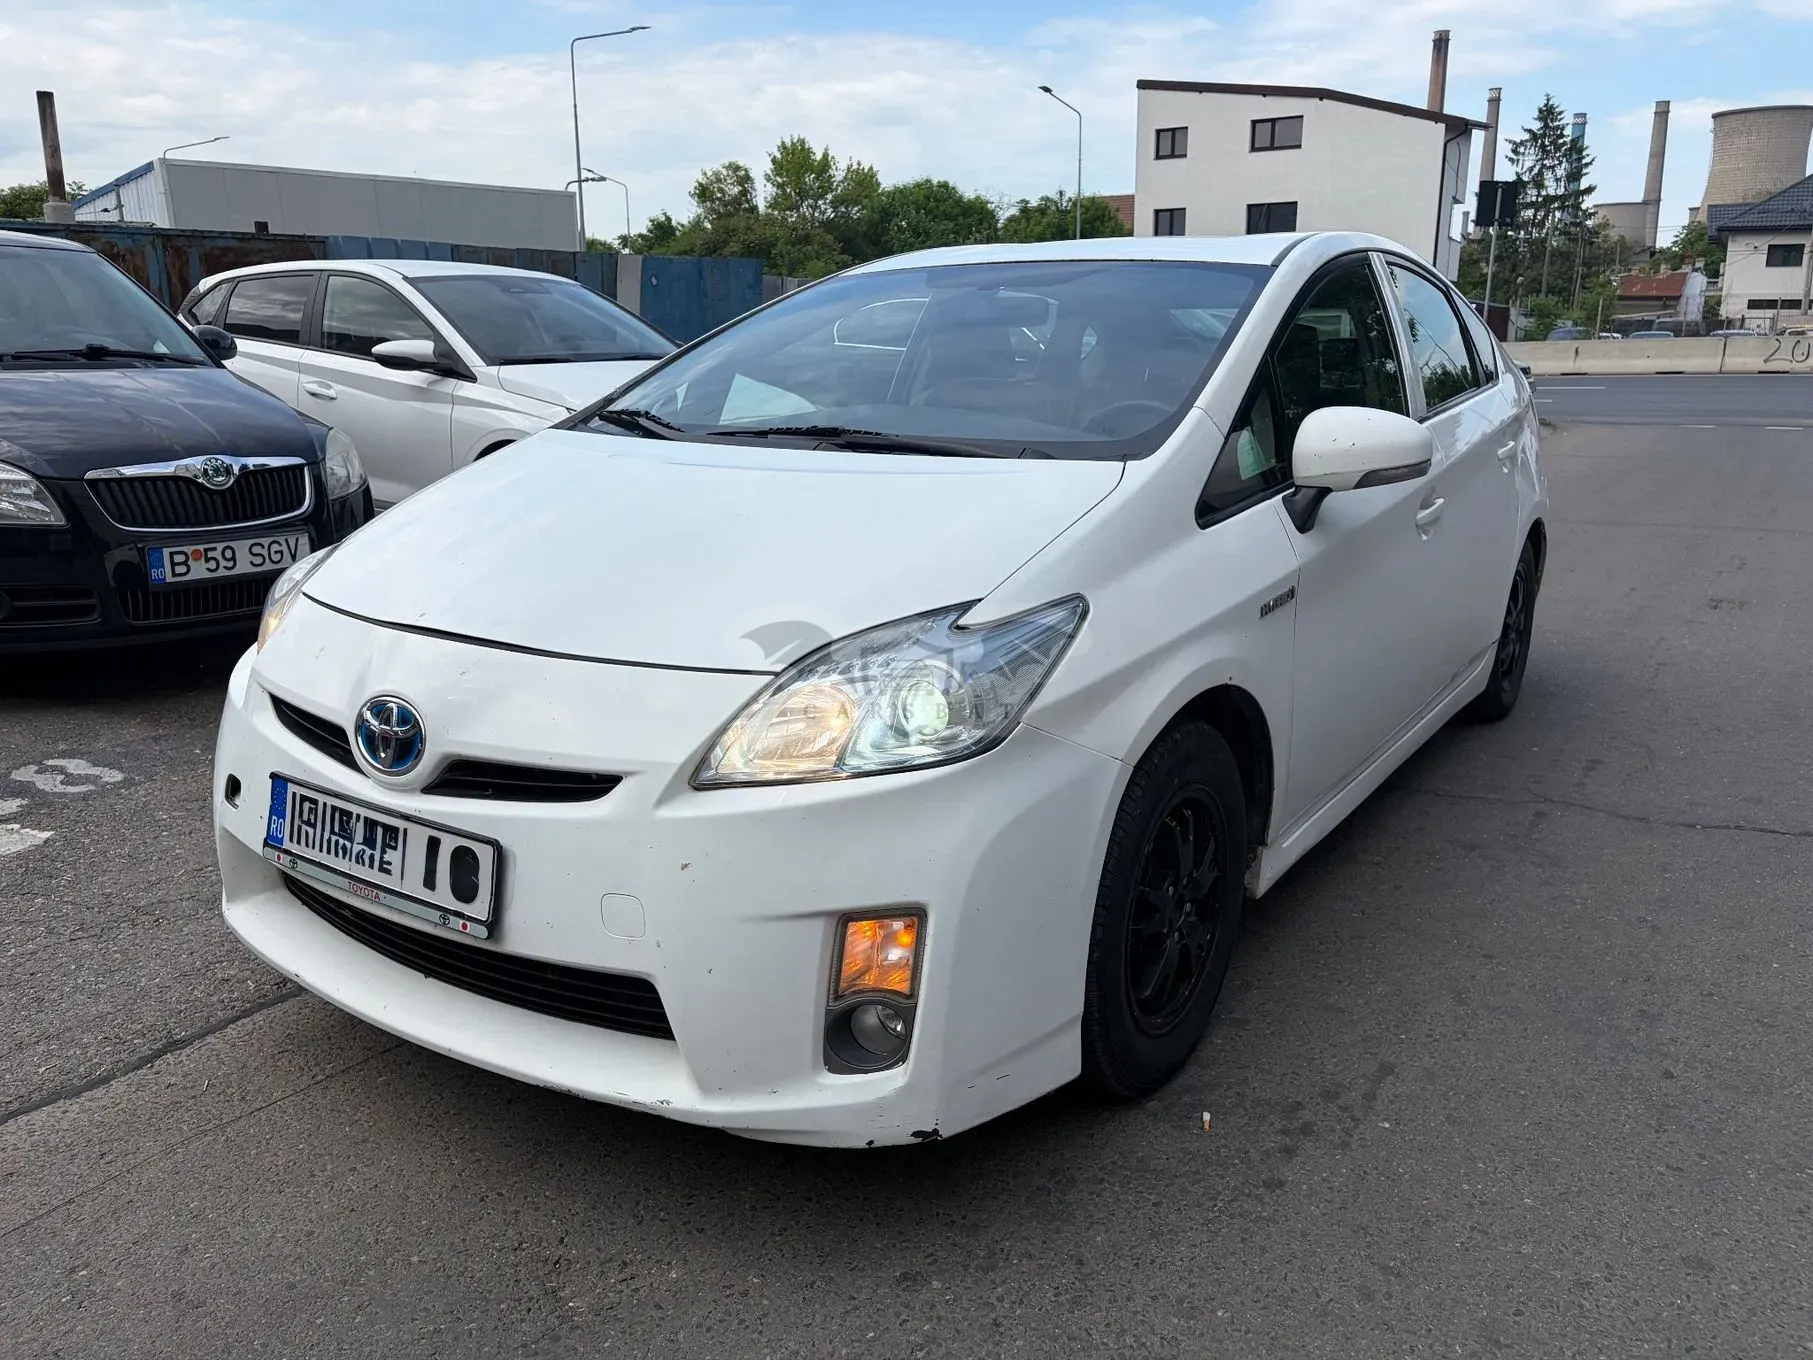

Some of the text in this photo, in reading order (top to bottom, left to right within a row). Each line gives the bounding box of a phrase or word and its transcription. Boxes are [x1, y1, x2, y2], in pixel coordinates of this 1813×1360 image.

[169, 537, 299, 577] B 59 SGV
[151, 568, 165, 580] RO
[270, 815, 284, 838] RO
[347, 881, 380, 901] TOYOTA
